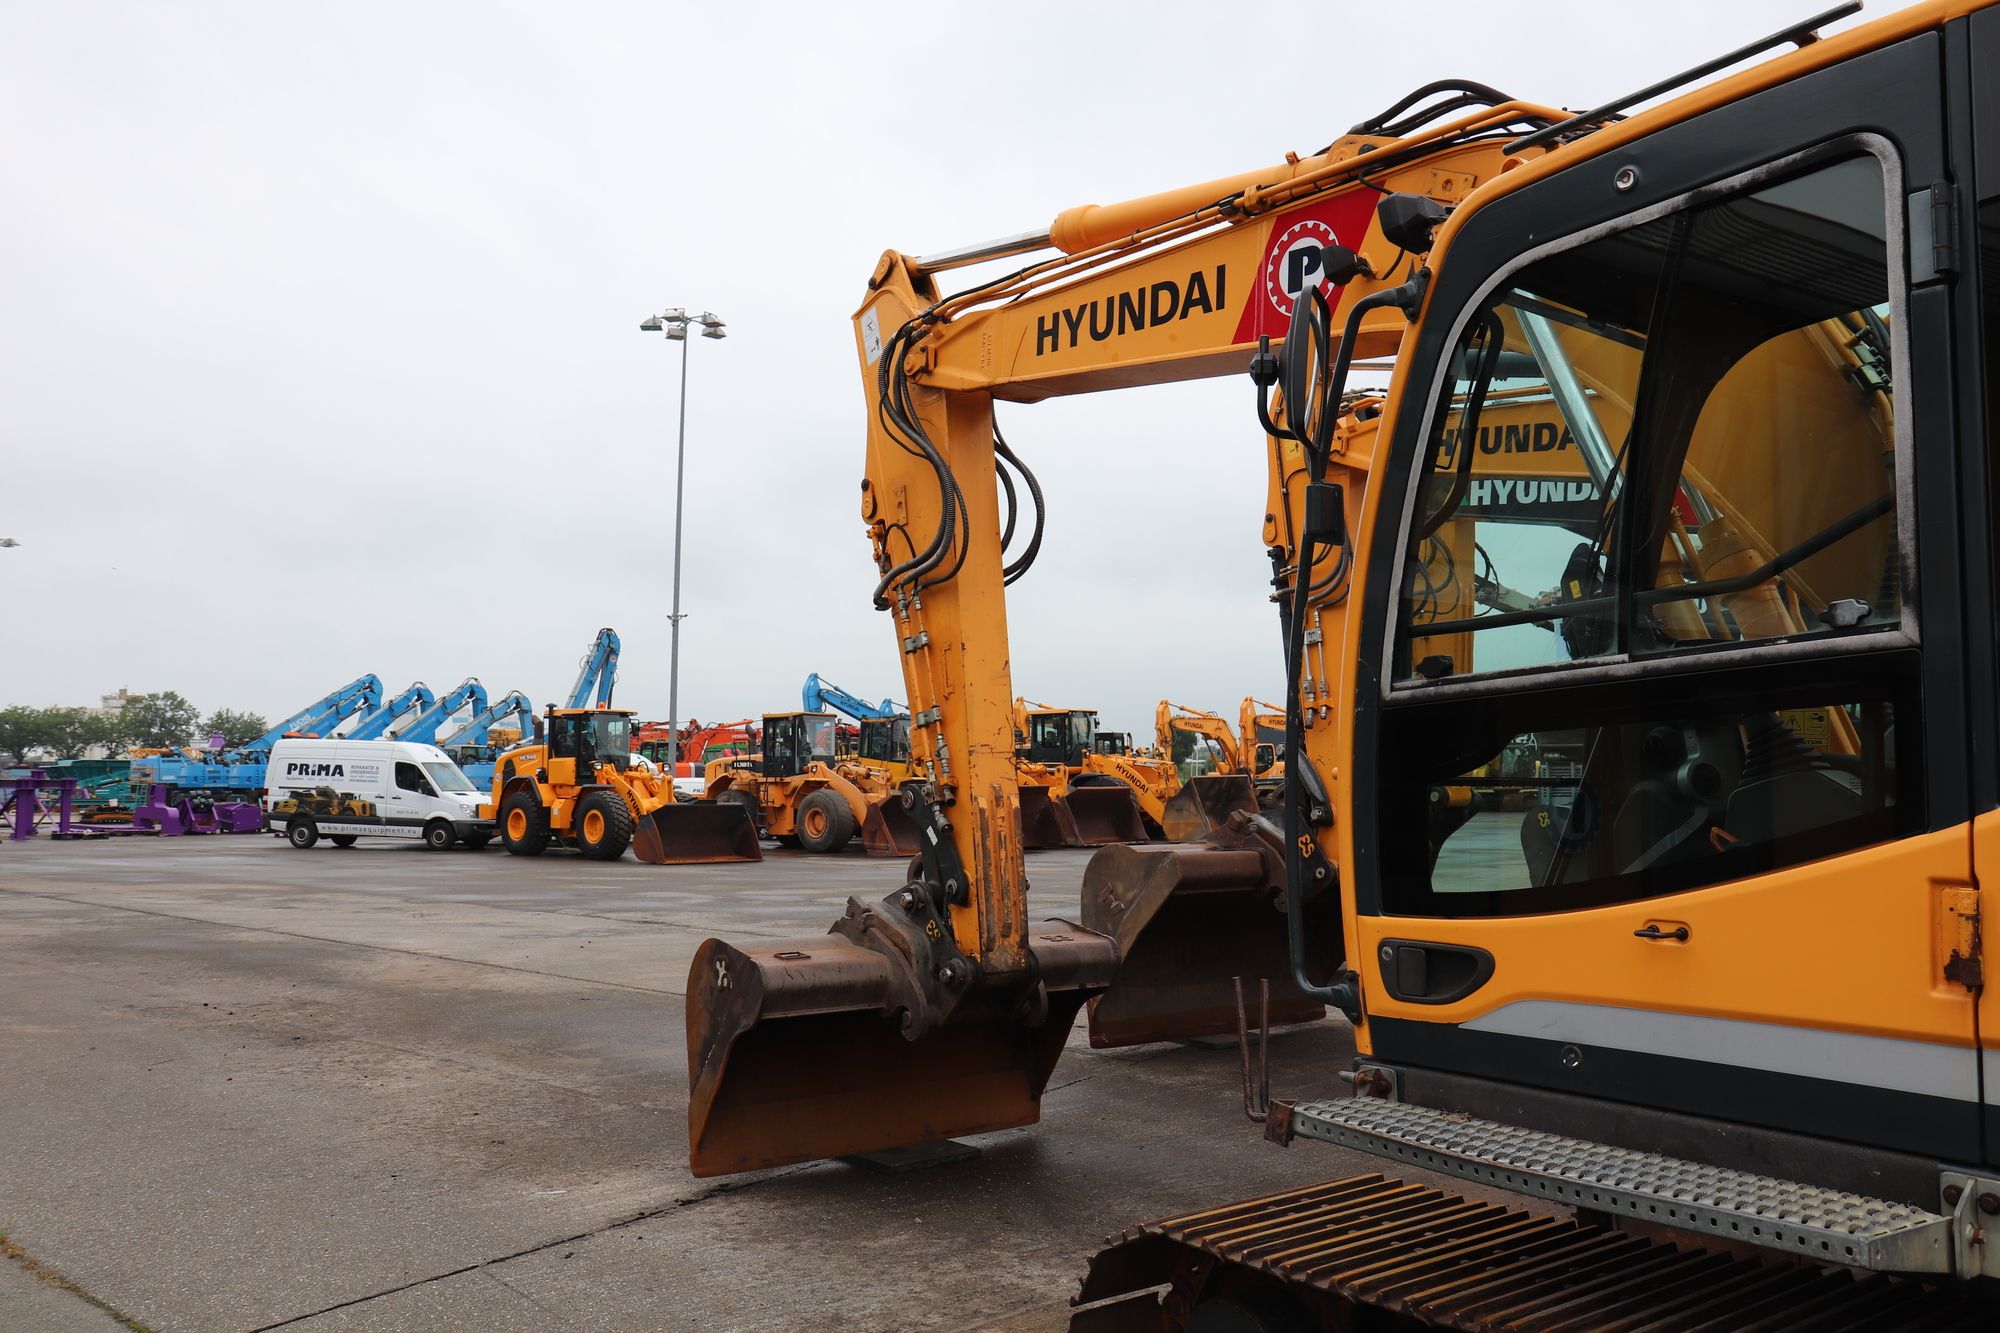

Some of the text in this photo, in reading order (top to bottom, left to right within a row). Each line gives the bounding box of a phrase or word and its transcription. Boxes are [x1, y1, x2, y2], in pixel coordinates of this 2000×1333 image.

[1036, 263, 1226, 356] HYUNDAI
[1184, 721, 1204, 730] HYUNDAI
[1115, 763, 1150, 794] HYUNDAI
[321, 825, 417, 835] www.primaequipment.eu
